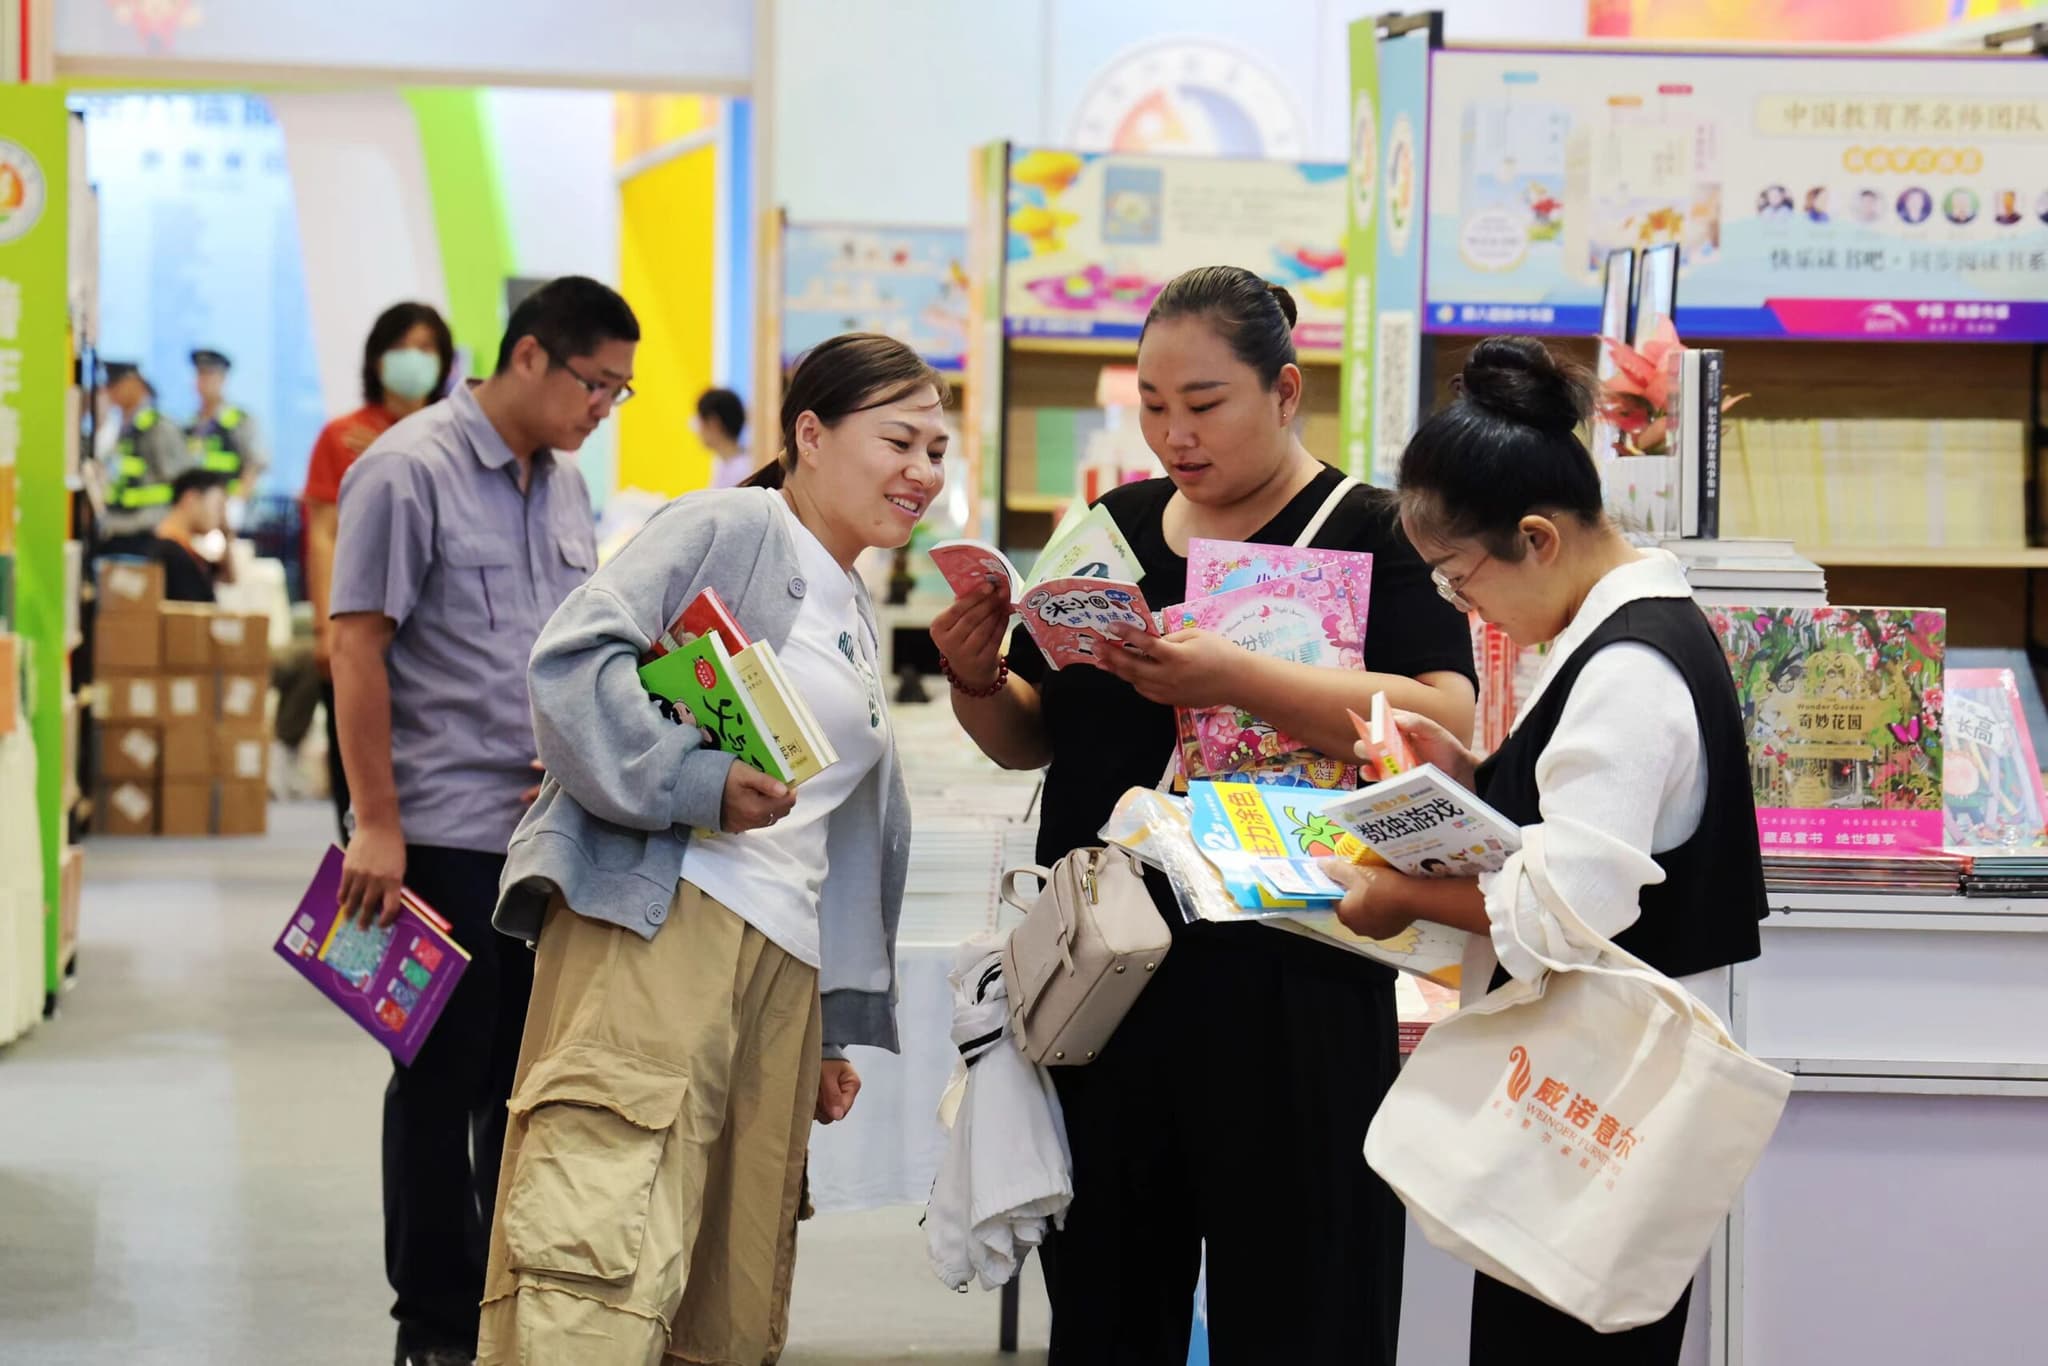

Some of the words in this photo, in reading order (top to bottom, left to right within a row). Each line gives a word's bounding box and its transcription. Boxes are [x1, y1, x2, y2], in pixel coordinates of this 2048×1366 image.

[1045, 596, 1110, 618] 米小圈
[1799, 713, 1863, 731] 奇妙花园
[1354, 798, 1465, 845] 数独游戏
[1533, 1076, 1638, 1160] 威诺意尔
